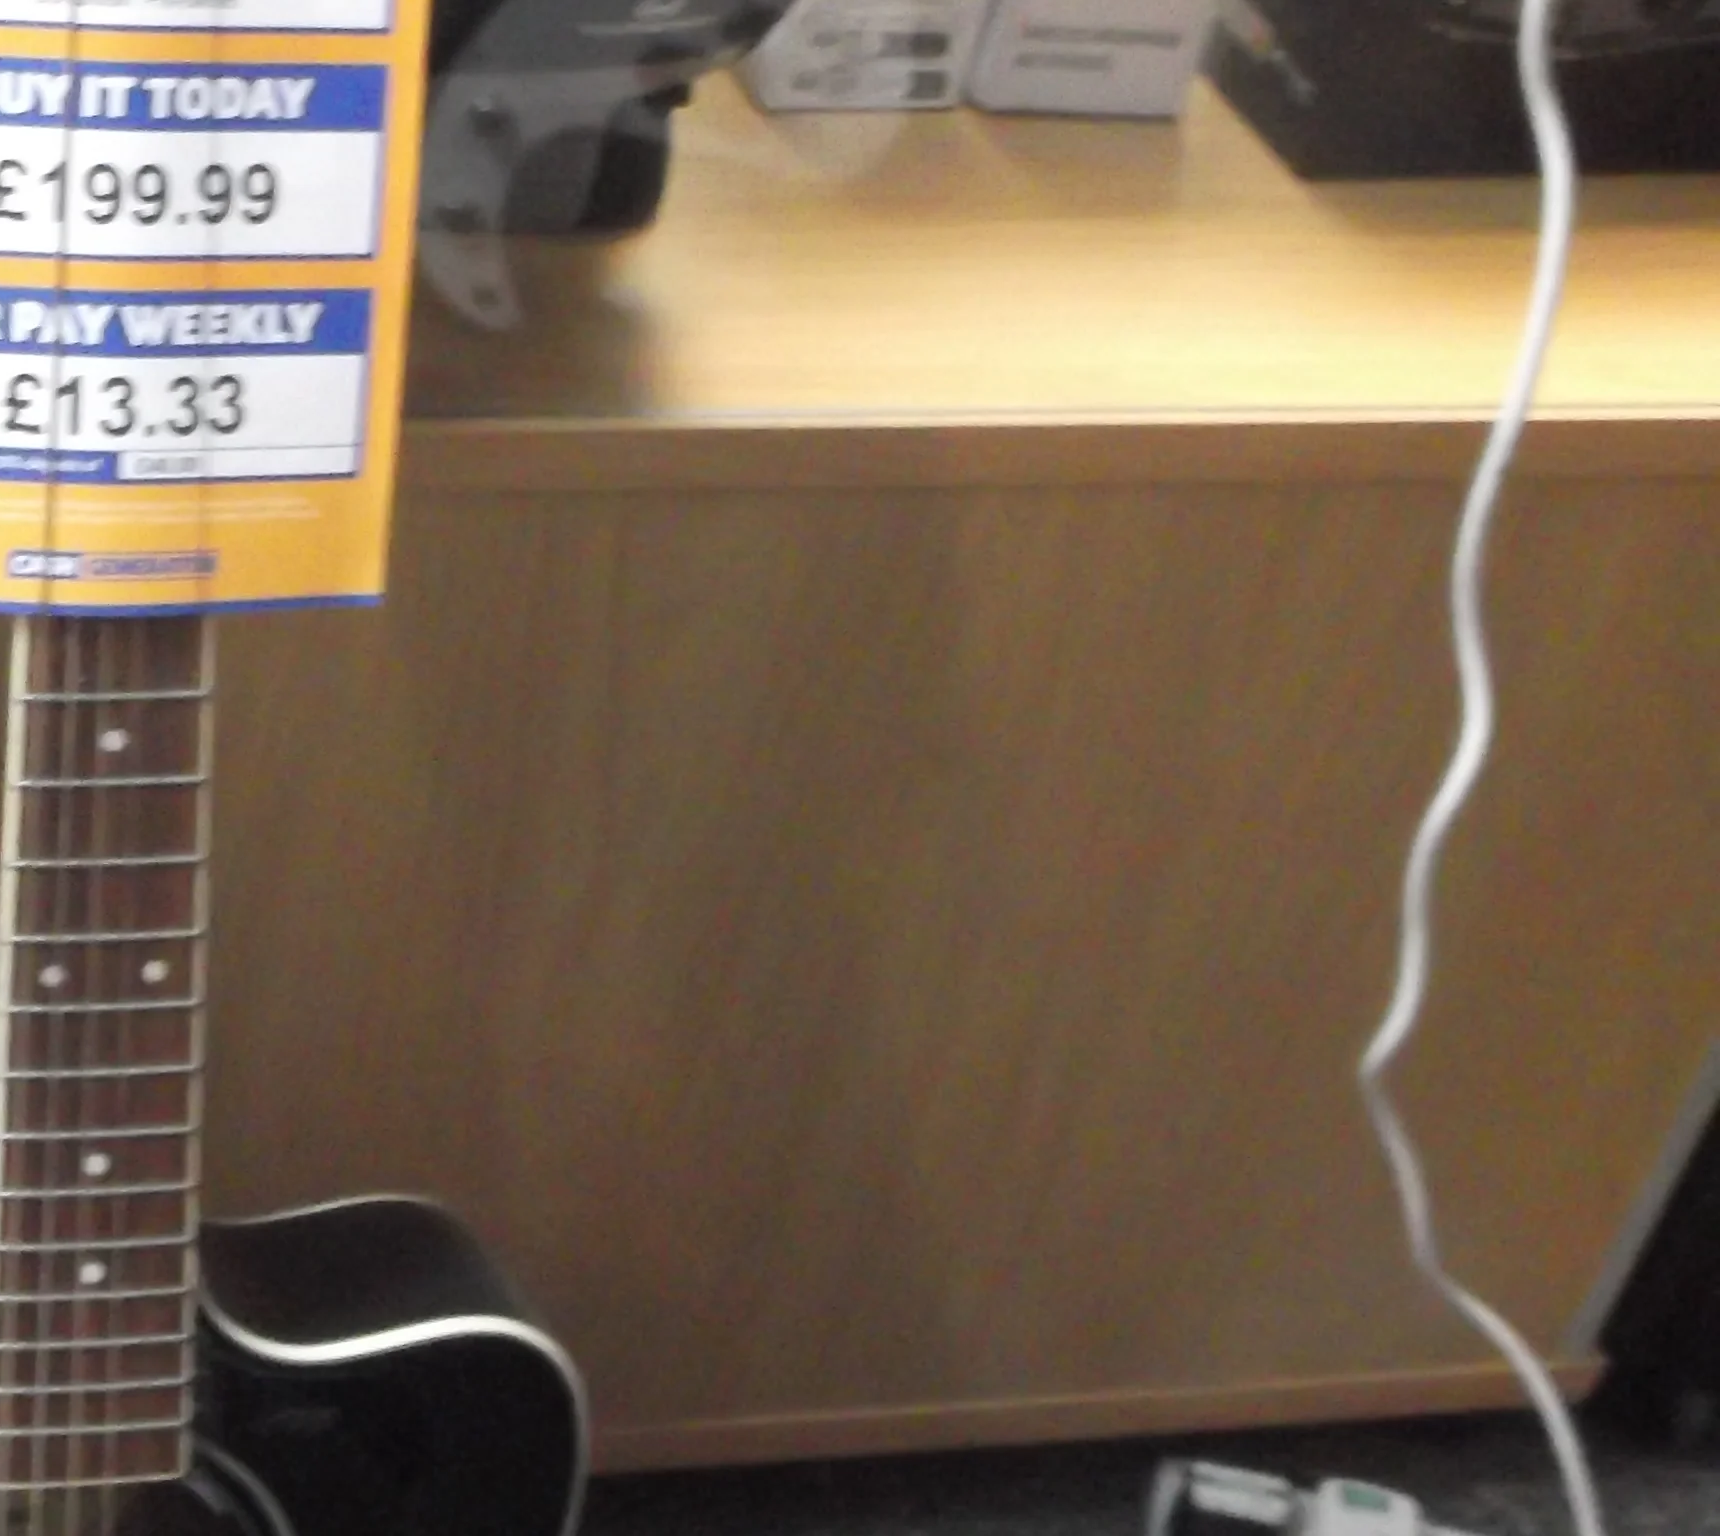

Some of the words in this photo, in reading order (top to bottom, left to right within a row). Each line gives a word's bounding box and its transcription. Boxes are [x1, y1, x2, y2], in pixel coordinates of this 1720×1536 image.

[80, 74, 139, 119] IT
[142, 77, 316, 120] TODAY
[8, 300, 116, 346] PAY
[118, 302, 326, 347] WEEKLY
[3, 373, 247, 437] £13.33
